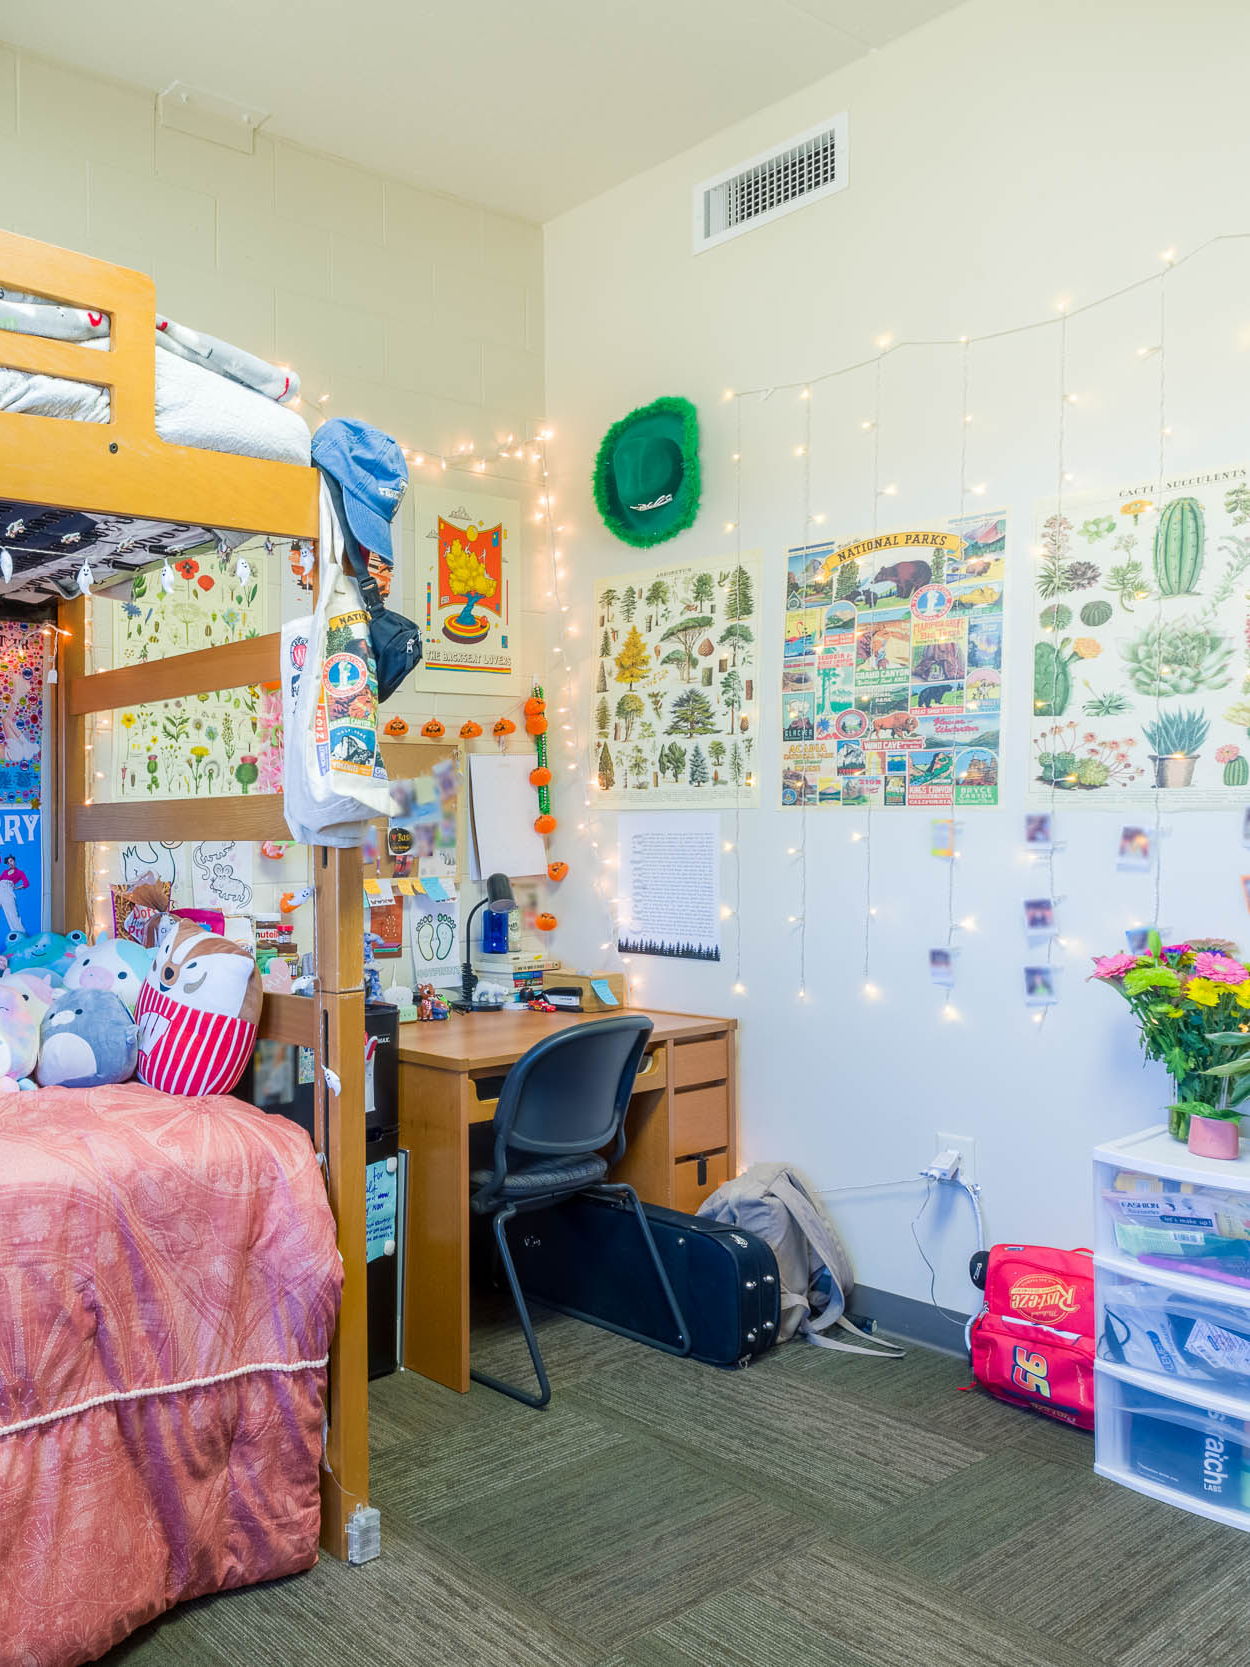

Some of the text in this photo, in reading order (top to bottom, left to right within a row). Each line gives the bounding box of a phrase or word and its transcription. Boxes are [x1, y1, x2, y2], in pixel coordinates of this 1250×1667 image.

[1119, 469, 1247, 497] CACTI SUCCULENTS
[837, 536, 899, 562] NATIONAL
[904, 533, 948, 546] PARKS
[316, 709, 325, 740] ZION
[784, 729, 813, 737] GLACIER
[790, 743, 827, 753] ACADIA
[863, 741, 883, 750] WIND
[884, 740, 902, 749] CAVE
[1120, 1201, 1160, 1209] FASHION
[1011, 1345, 1051, 1399] 95
